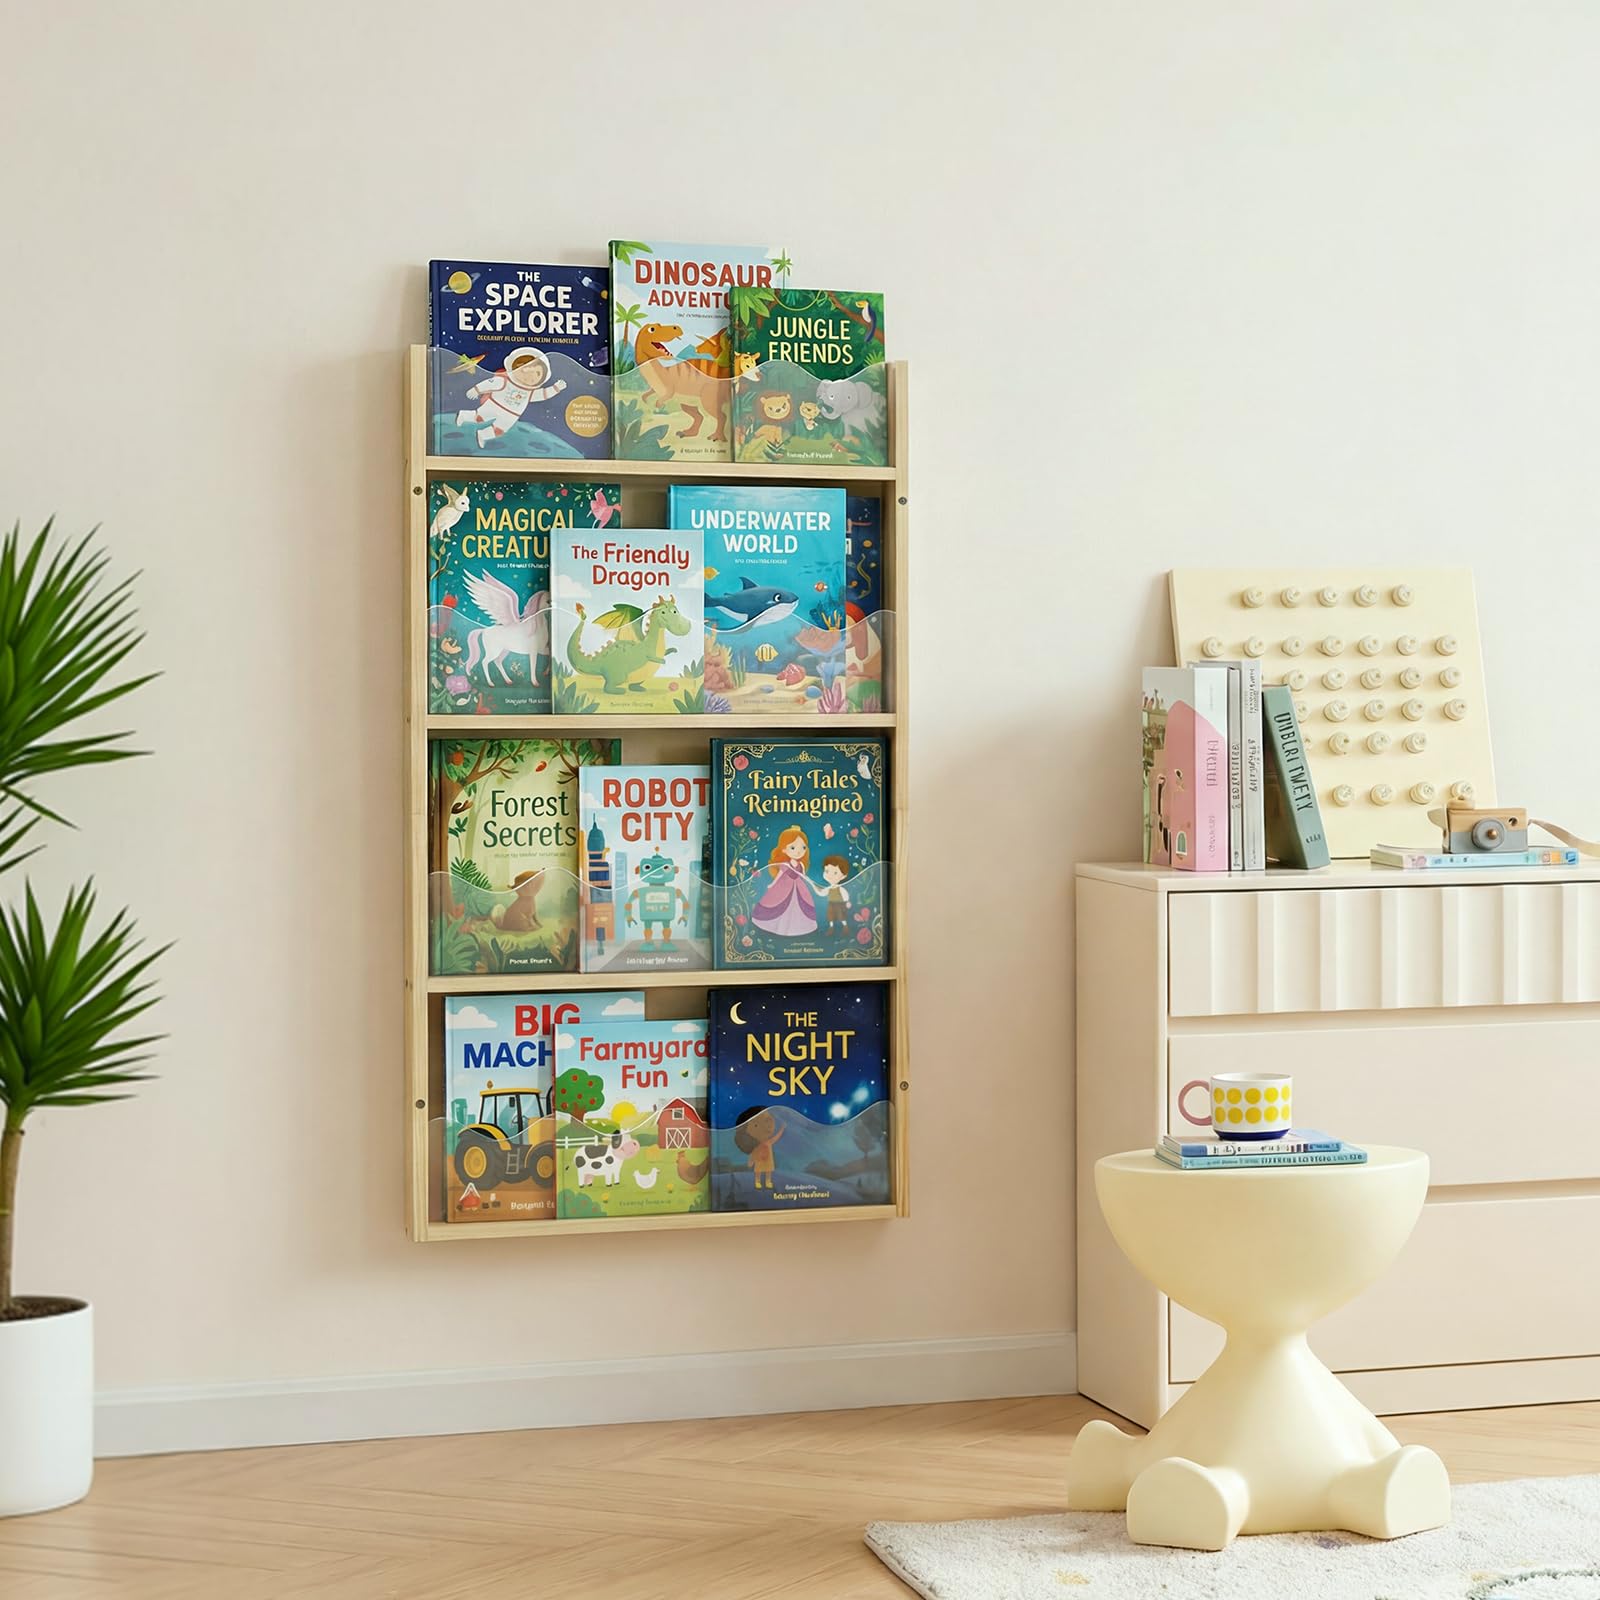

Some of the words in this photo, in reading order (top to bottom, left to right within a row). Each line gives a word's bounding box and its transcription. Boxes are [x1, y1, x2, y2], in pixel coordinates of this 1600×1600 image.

[517, 271, 540, 282] THE
[635, 259, 772, 288] DINOSAUR
[485, 283, 572, 309] SPACE
[458, 308, 599, 335] EXPLORER
[769, 316, 851, 340] JUNGLE
[768, 341, 854, 365] FRIENDS
[691, 509, 831, 531] UNDERWATER
[571, 545, 598, 560] The
[604, 542, 690, 570] Friendly
[723, 533, 798, 554] WORLD
[592, 564, 670, 591] Dragon
[603, 778, 710, 808] ROBOT
[748, 769, 803, 795] Fairy
[806, 769, 859, 789] Tales
[491, 790, 570, 818] Forest
[743, 792, 863, 818] Reimagined
[483, 820, 577, 848] Secrets
[621, 812, 694, 842] CITY
[515, 1003, 580, 1036] BIG
[784, 1011, 818, 1028] THE
[580, 1036, 710, 1066] Farmyard
[746, 1031, 856, 1063] NIGHT
[622, 1065, 668, 1089] Fun
[768, 1065, 835, 1097] SKY
